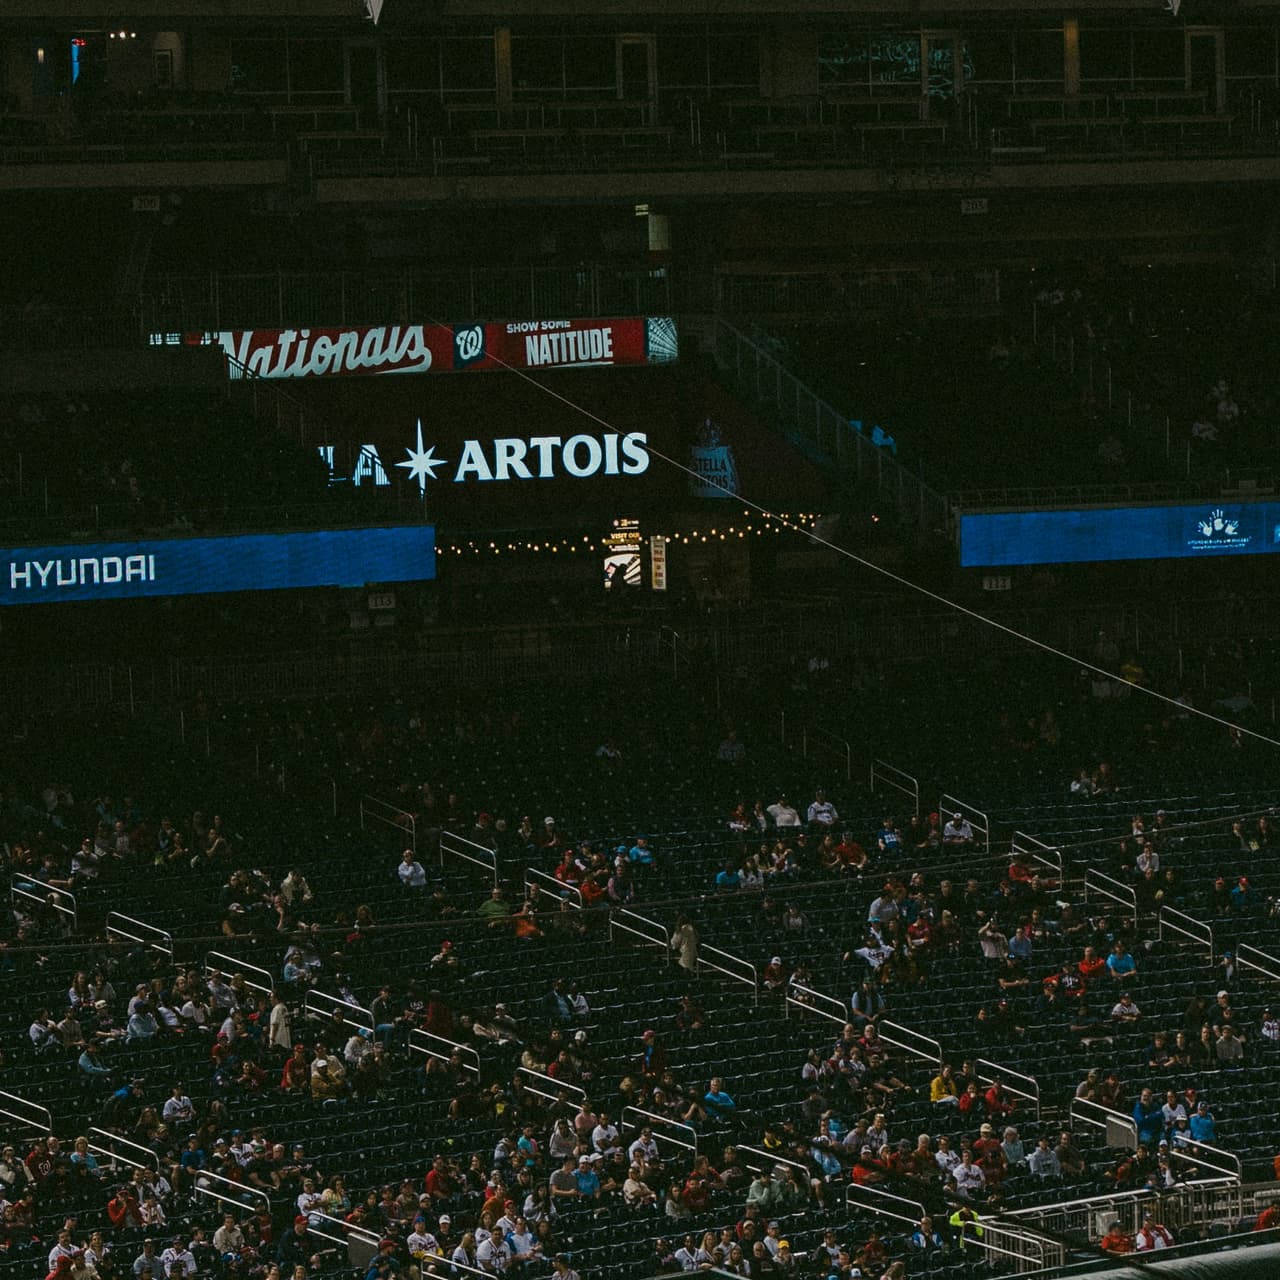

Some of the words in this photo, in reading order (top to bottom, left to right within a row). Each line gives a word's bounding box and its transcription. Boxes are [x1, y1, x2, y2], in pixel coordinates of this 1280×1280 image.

[506, 321, 539, 334] SHOW
[541, 320, 571, 331] SOME
[526, 327, 613, 367] NATITUDE
[454, 432, 650, 482] ARTOIS
[10, 554, 155, 589] HYUNDAI
